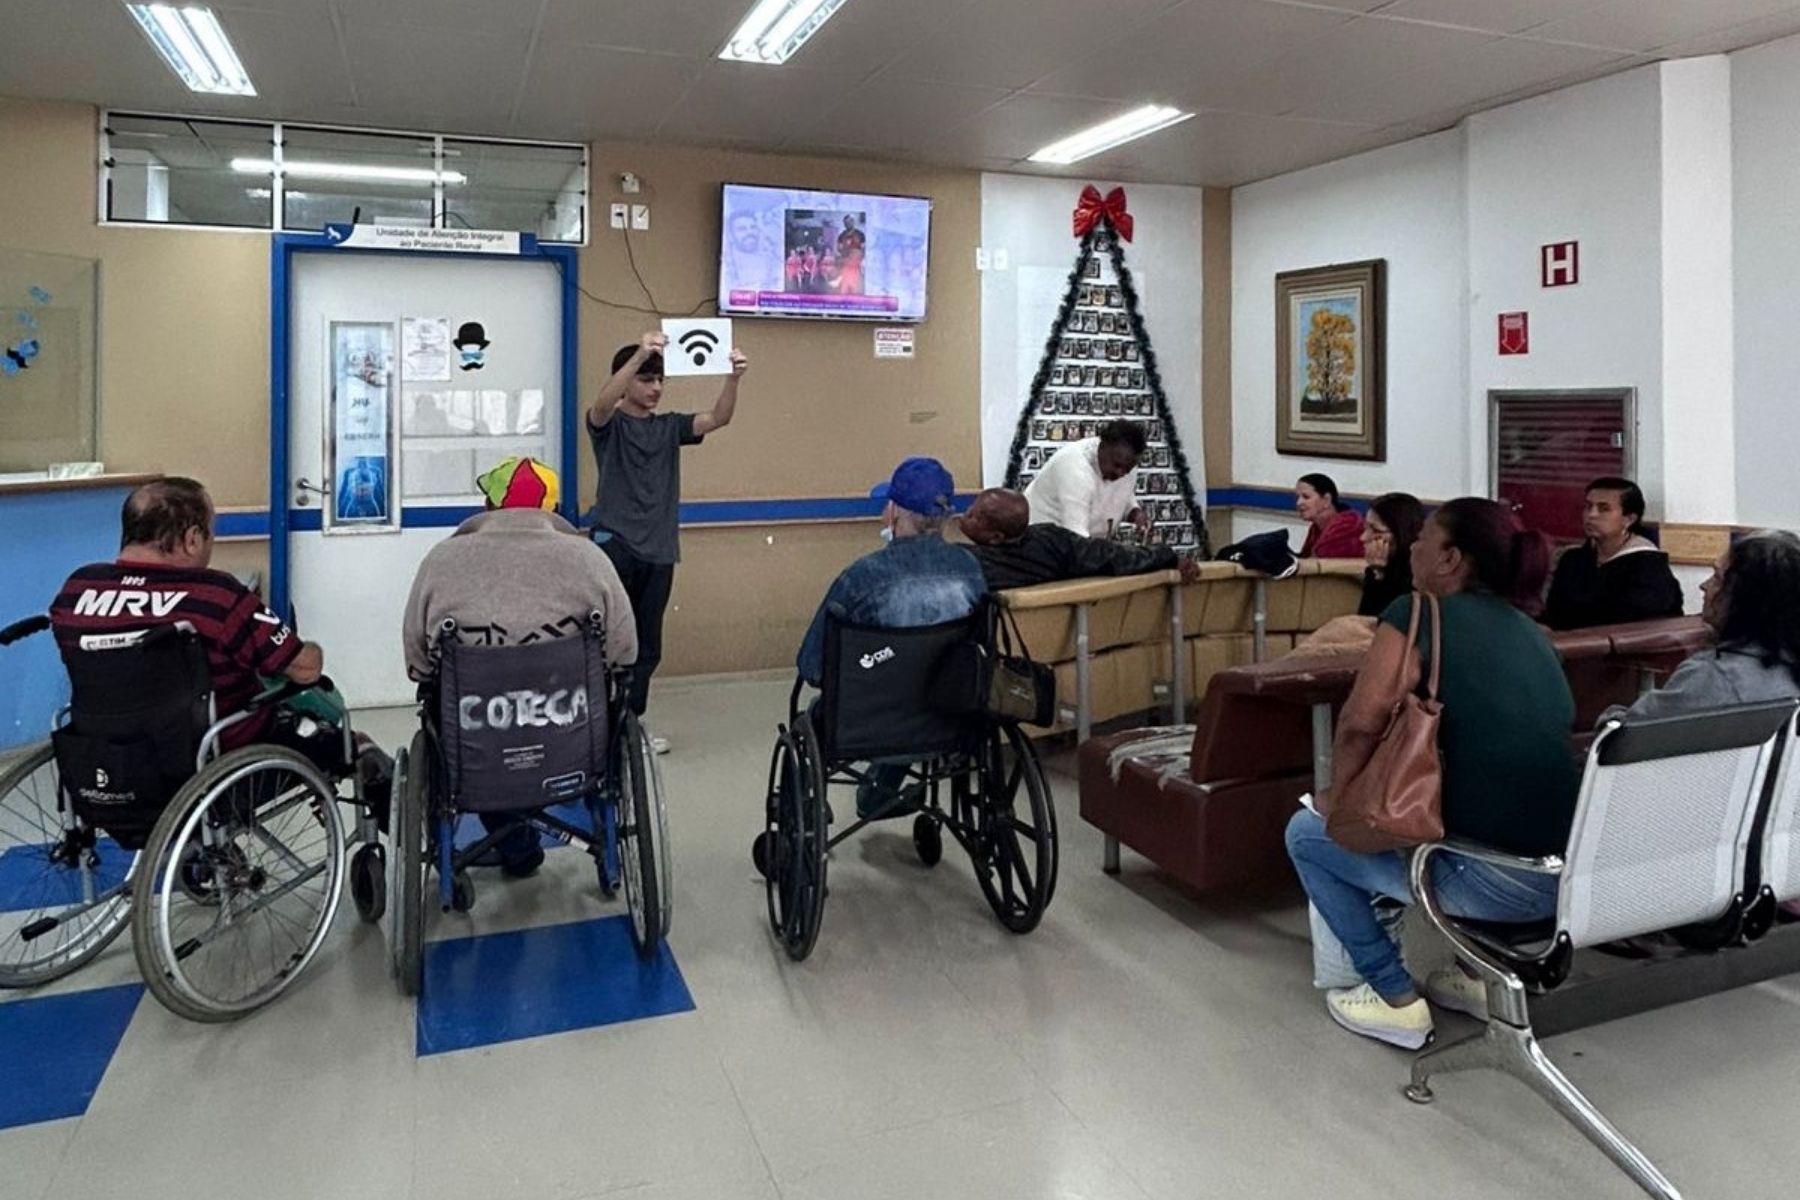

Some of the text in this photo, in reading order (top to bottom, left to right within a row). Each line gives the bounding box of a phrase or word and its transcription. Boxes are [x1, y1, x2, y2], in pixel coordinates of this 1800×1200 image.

[376, 228, 504, 242] Unidade de Atenção Integral
[400, 239, 482, 250] ao Paciente Renal
[1546, 243, 1574, 285] H
[73, 588, 188, 618] MRV
[459, 686, 588, 731] COTECA
